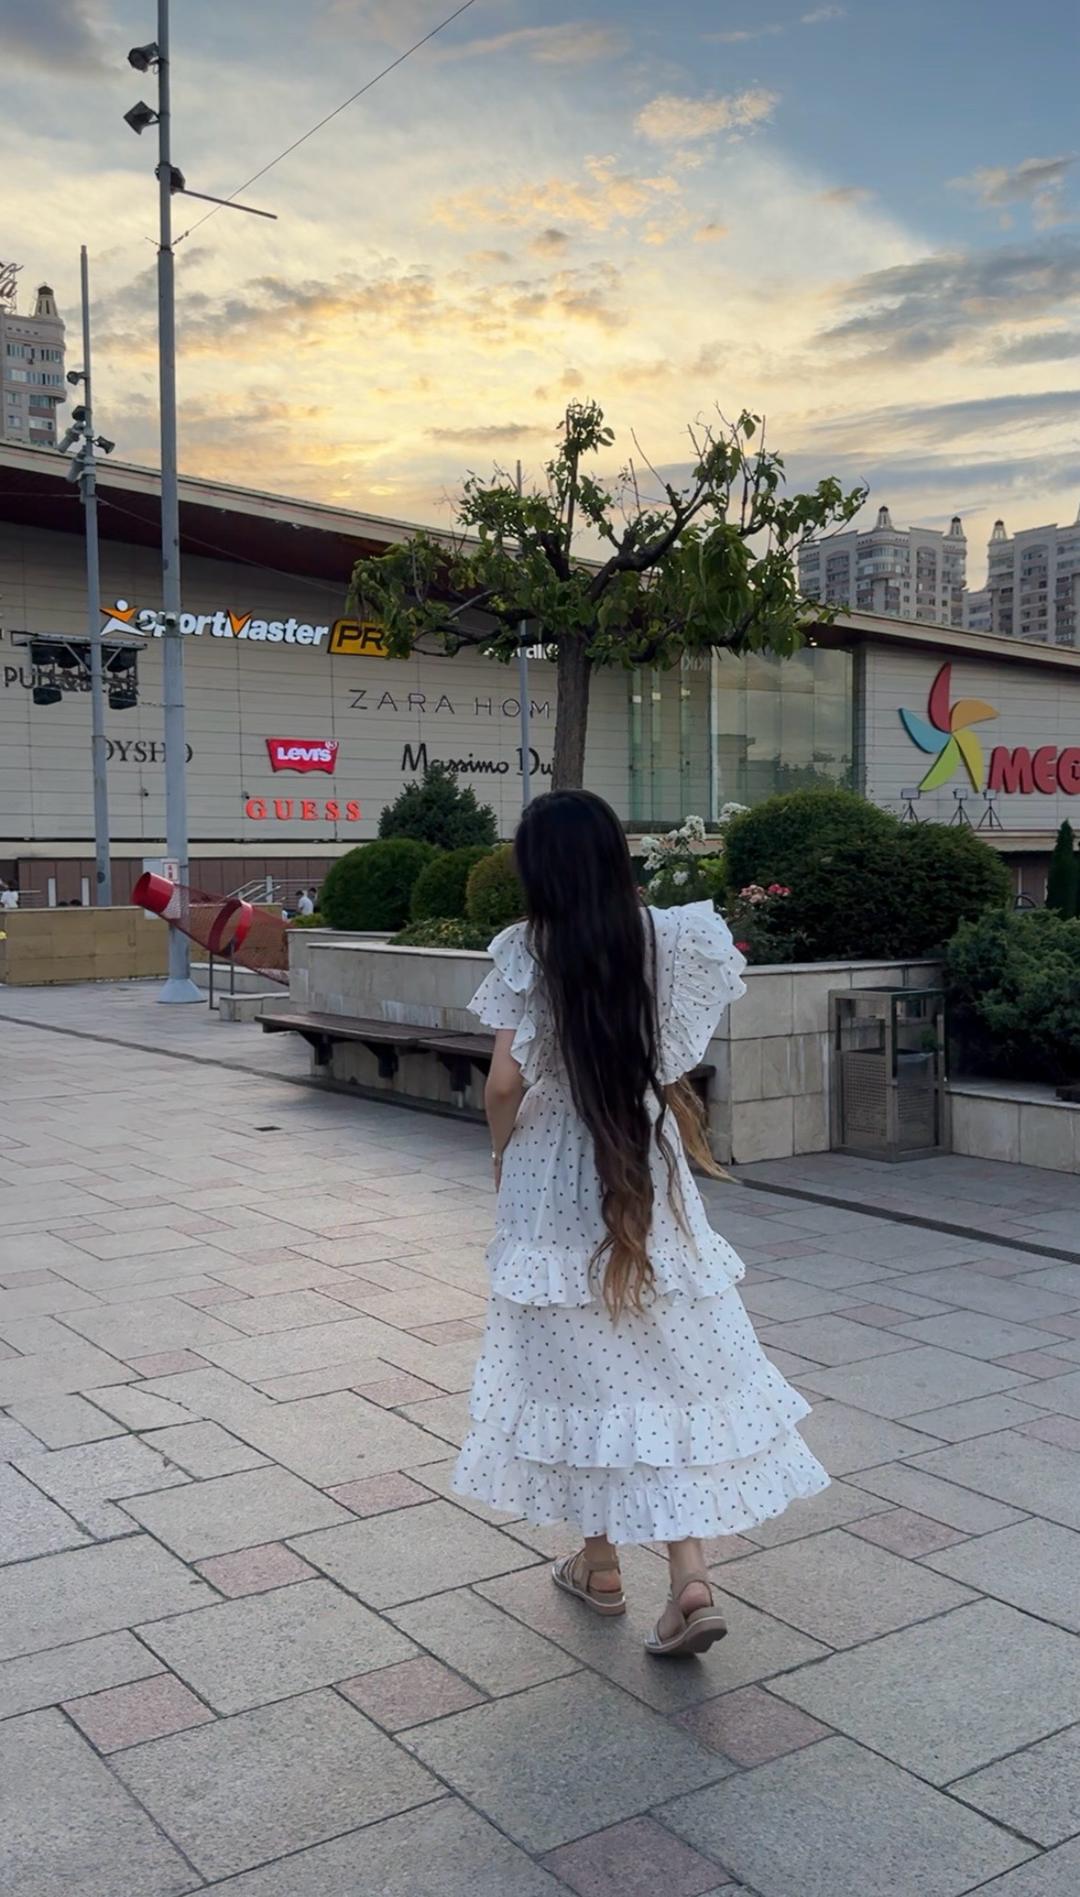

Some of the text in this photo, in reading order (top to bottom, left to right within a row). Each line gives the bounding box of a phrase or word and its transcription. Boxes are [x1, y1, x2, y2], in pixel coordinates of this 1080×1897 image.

[336, 625, 387, 651] PR
[349, 689, 550, 719] ZARA HOM
[401, 743, 555, 777] Massimo Du
[245, 799, 361, 822] GUESS
